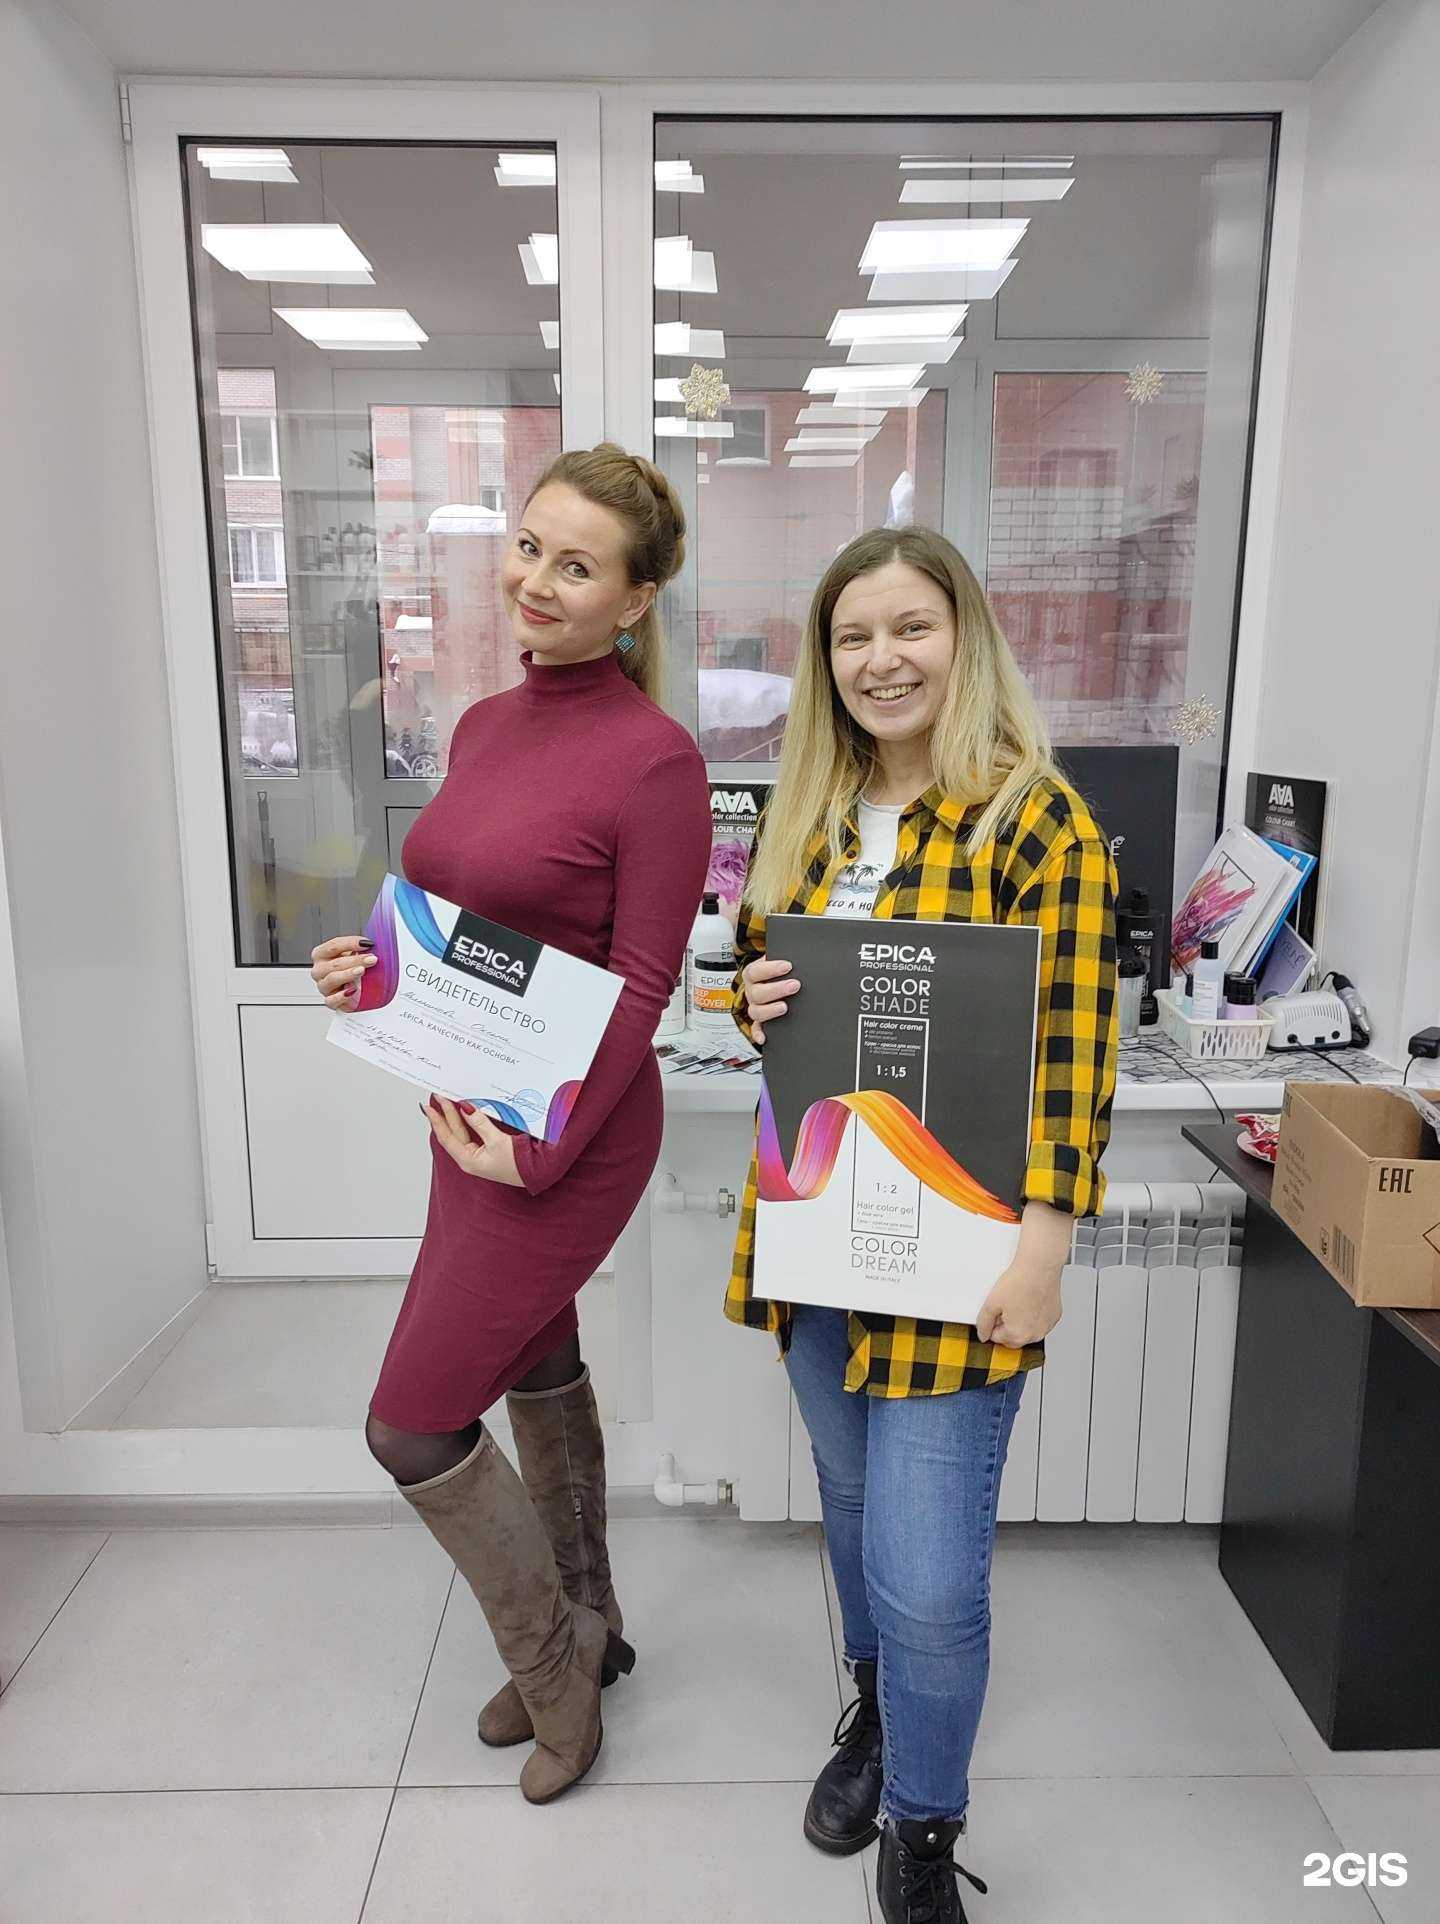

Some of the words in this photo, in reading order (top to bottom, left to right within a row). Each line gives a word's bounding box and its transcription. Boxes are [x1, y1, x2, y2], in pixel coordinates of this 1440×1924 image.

[1130, 930, 1153, 938] EPICA
[453, 935, 527, 979] EPICA
[857, 943, 937, 964] EPICA
[452, 952, 521, 988] PROFESSIONAL
[859, 961, 935, 973] PROFESSIONAL
[700, 976, 732, 986] EPICA
[860, 976, 931, 996] COLOR
[405, 963, 546, 1034] СВИДЕТЕЛЬСТВО
[860, 995, 930, 1015] SHADE
[863, 1019, 878, 1029] Hair
[879, 1020, 899, 1030] color
[427, 1023, 466, 1043] КАЧЕСТВО
[467, 1039, 482, 1052] КАК
[1378, 1167, 1414, 1194] EAC
[857, 1201, 874, 1210] Hair
[876, 1203, 899, 1213] color
[900, 1206, 914, 1215] gel
[851, 1236, 918, 1257] COLOR
[851, 1253, 916, 1275] DREAM
